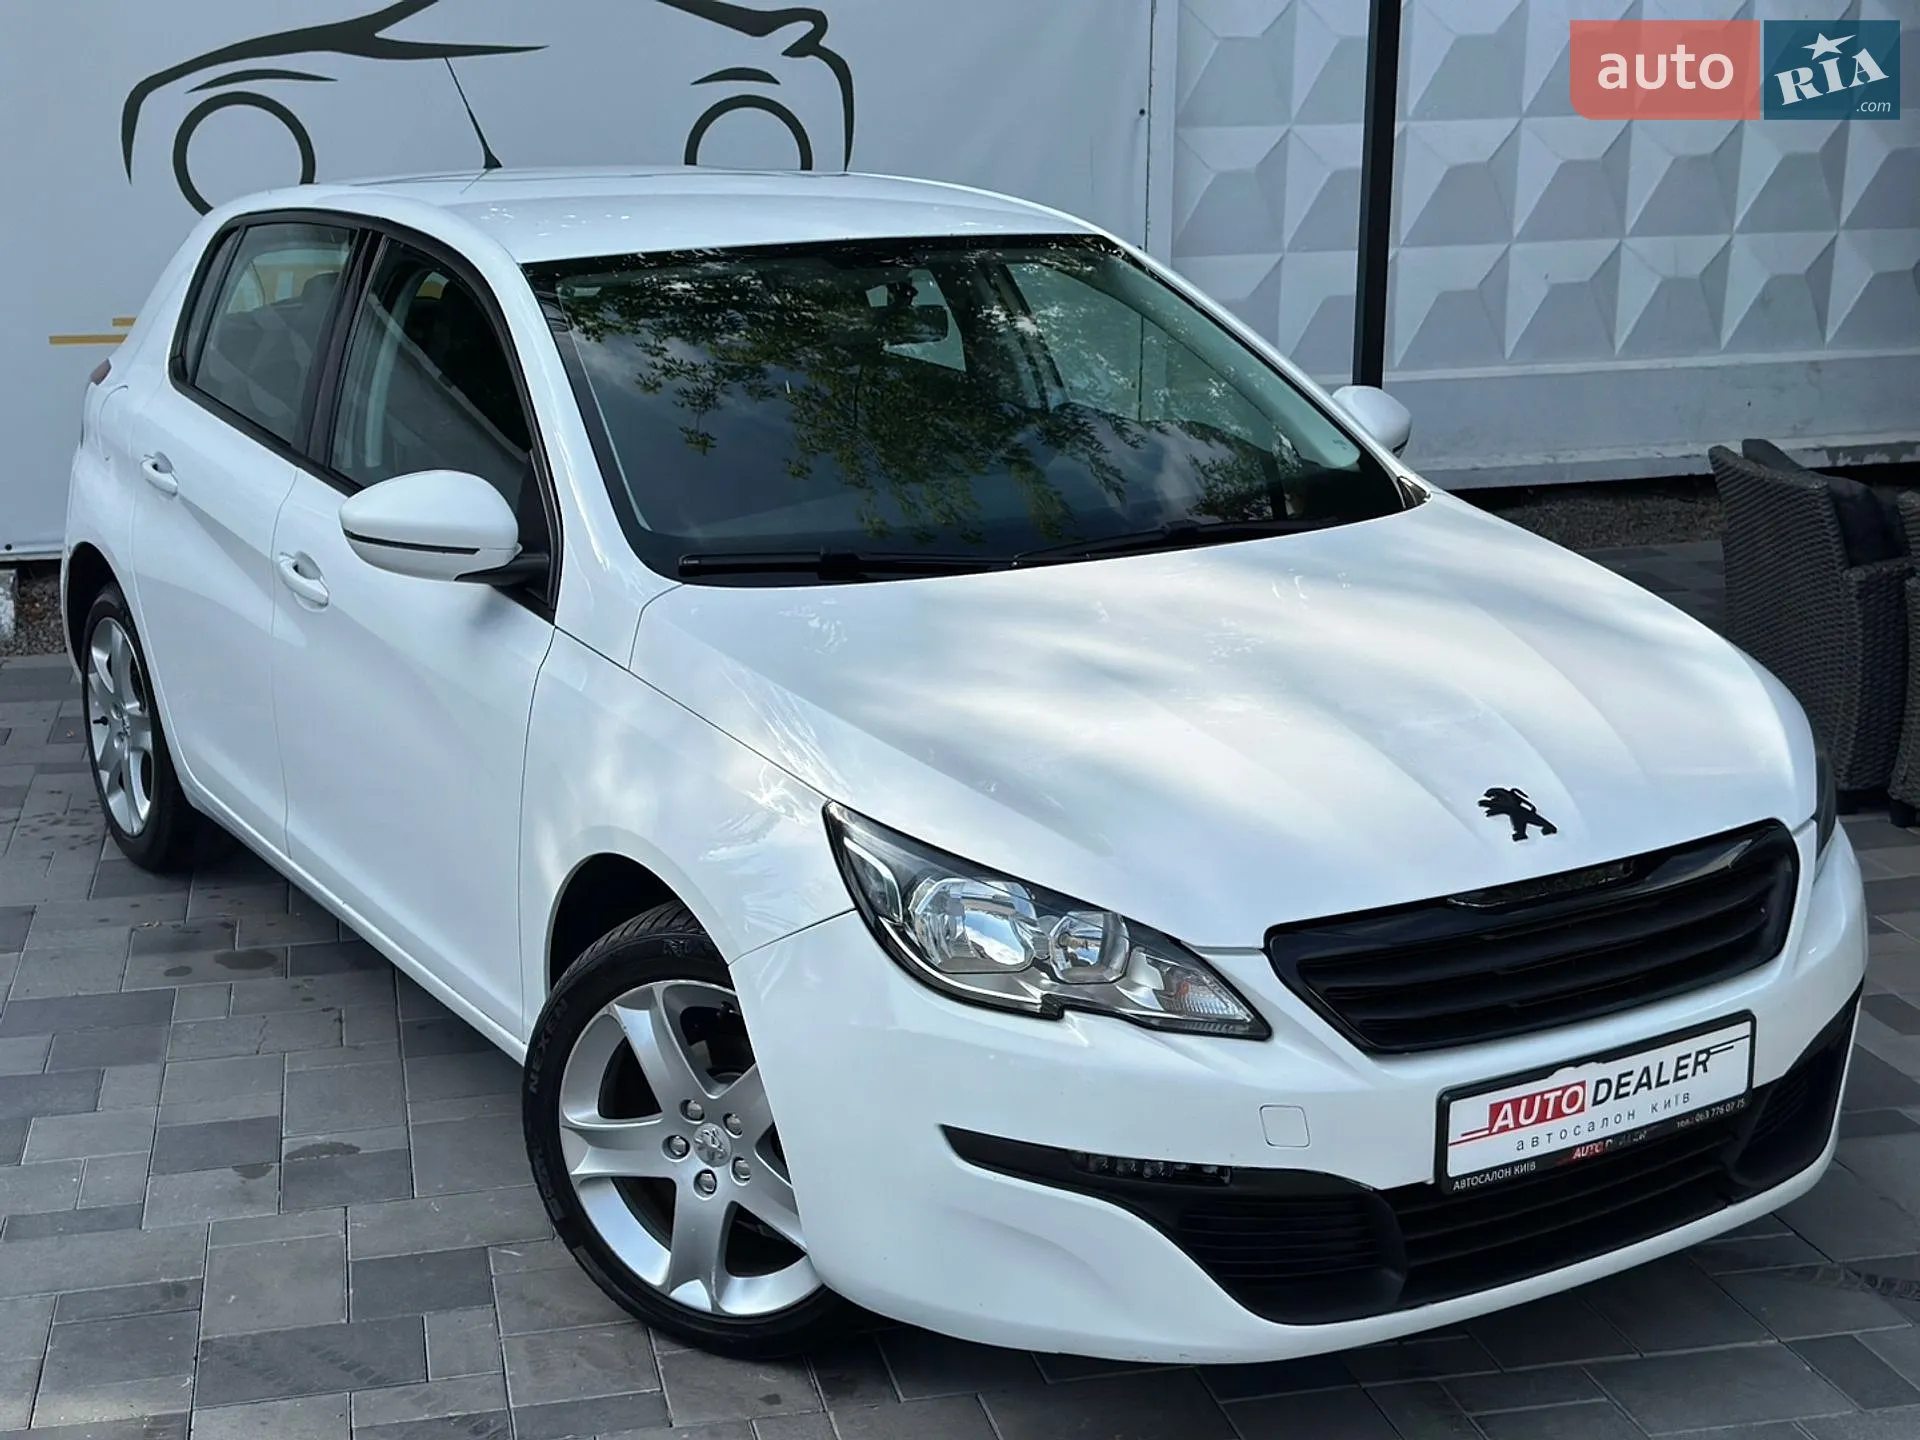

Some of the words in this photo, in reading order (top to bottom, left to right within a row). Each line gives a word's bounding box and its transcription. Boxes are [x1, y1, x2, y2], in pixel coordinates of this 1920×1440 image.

[1491, 1084, 1586, 1133] AUTO
[1591, 1049, 1711, 1107] DEALER
[1516, 1110, 1635, 1151] автосалон
[1453, 1167, 1511, 1191] АВТОСАЛОН
